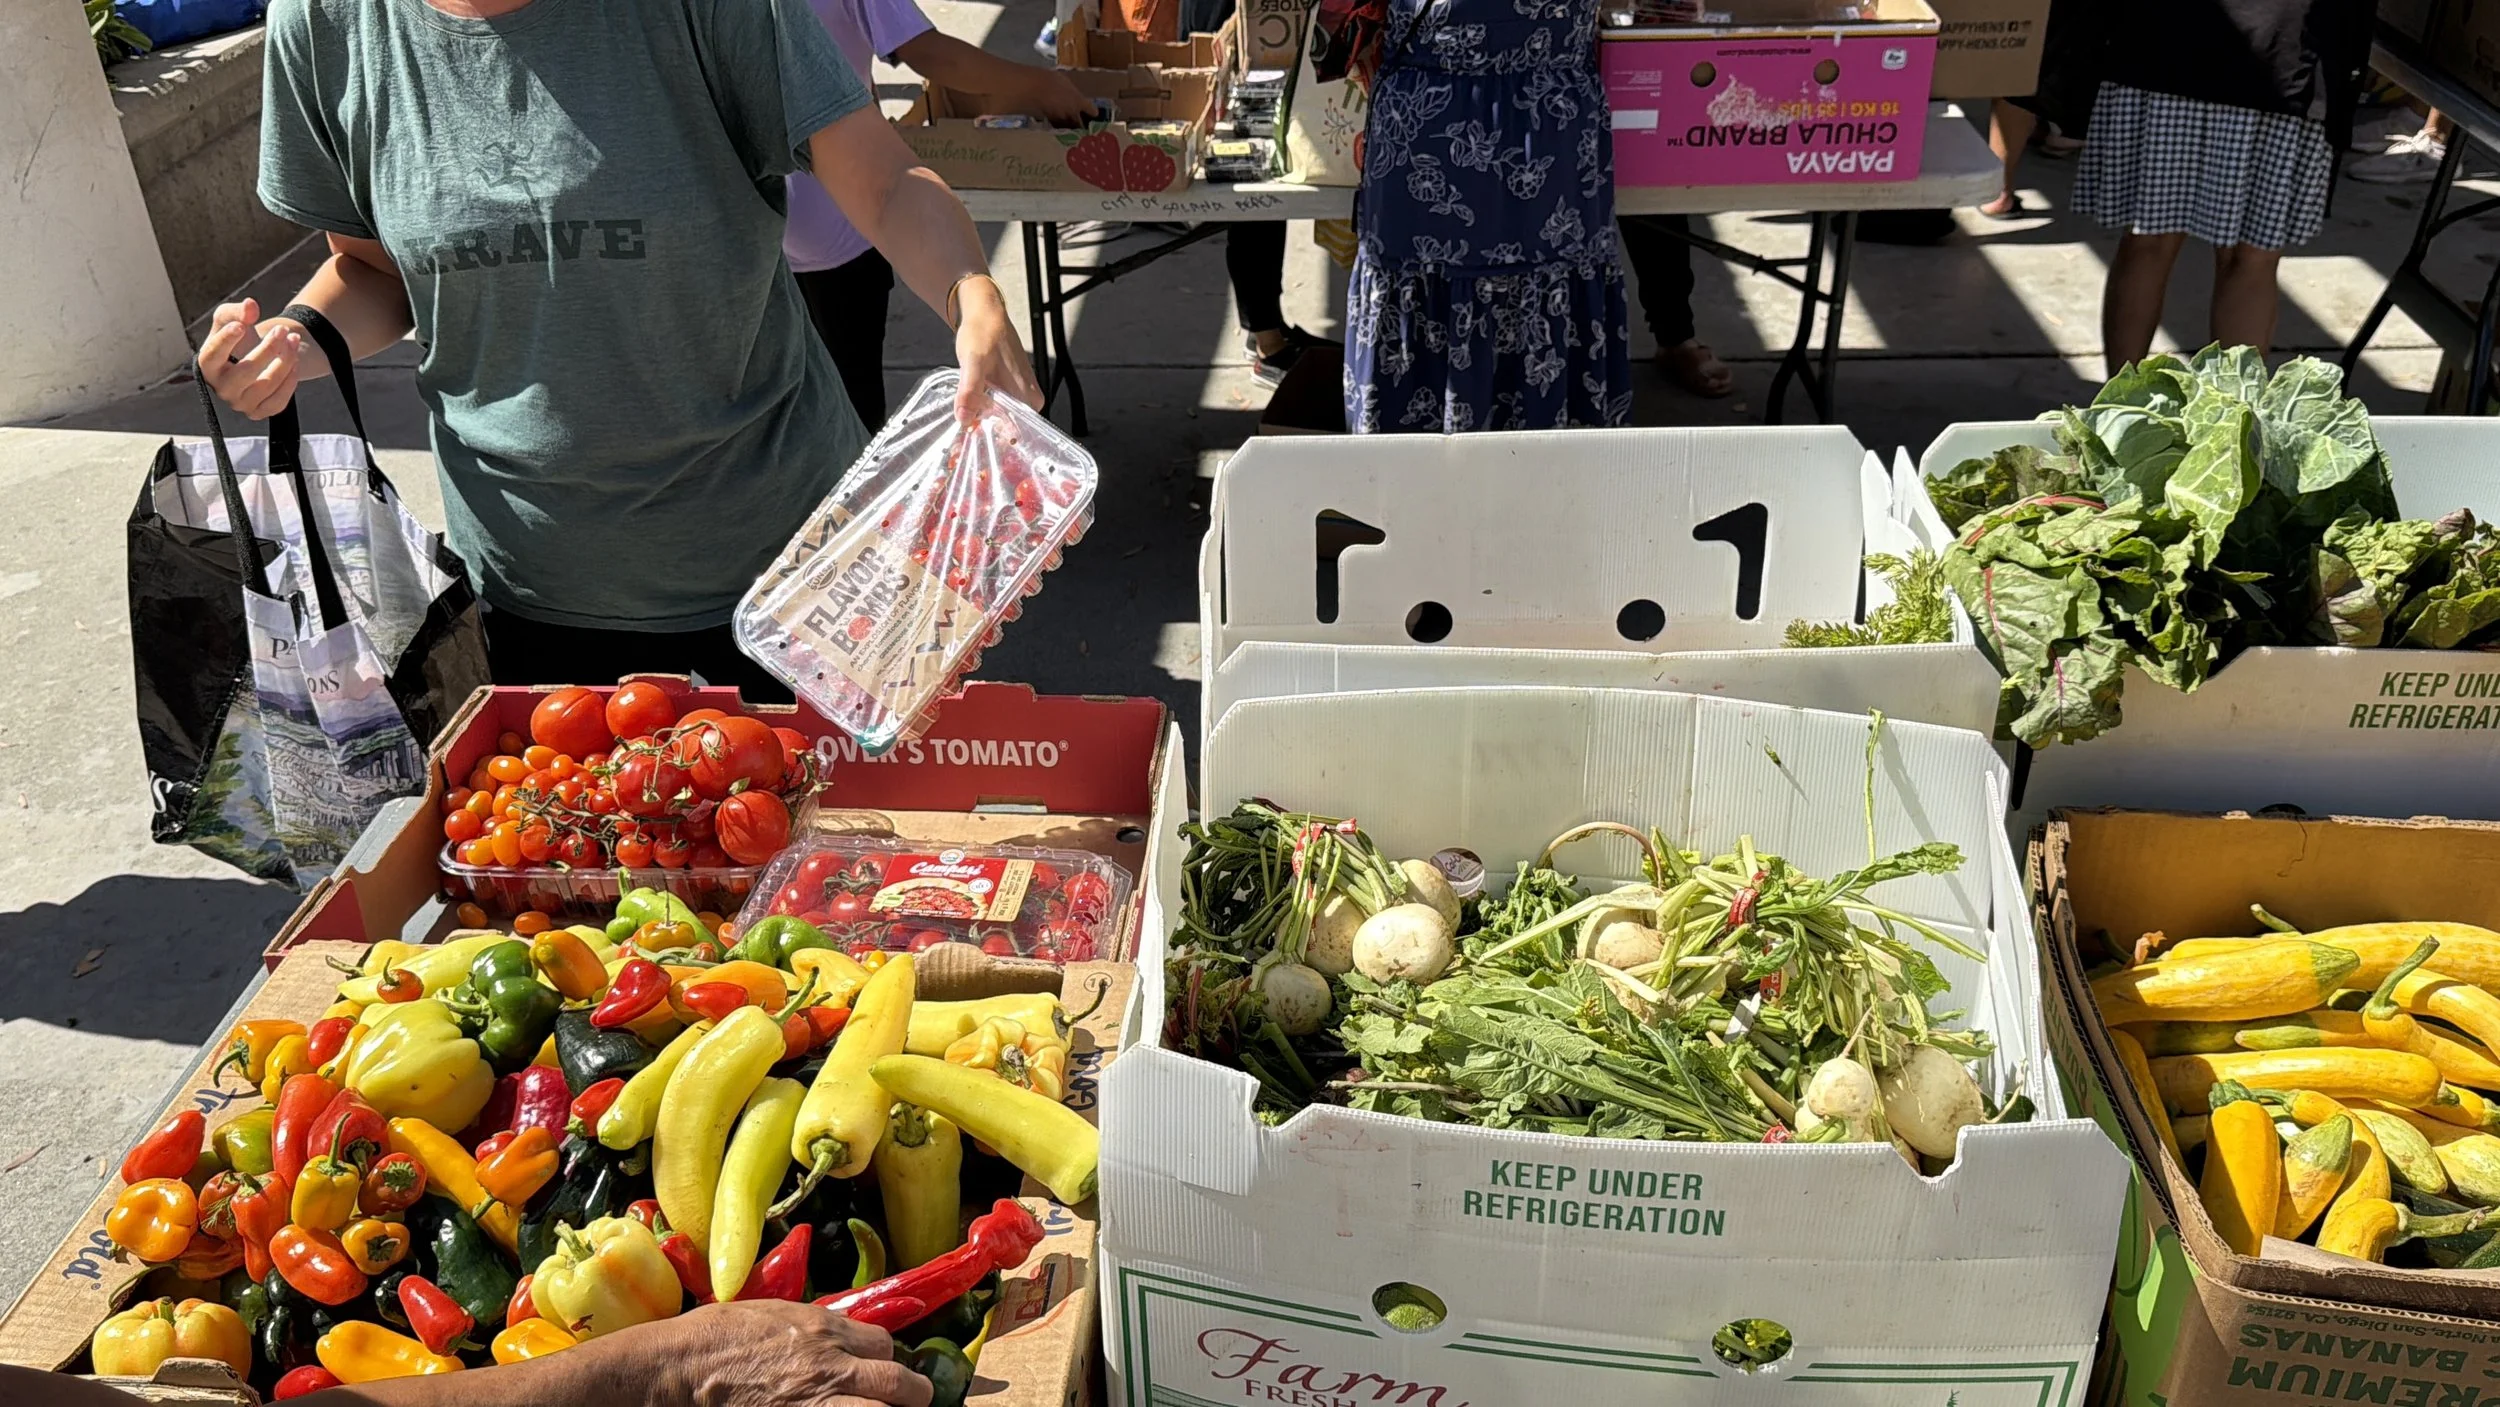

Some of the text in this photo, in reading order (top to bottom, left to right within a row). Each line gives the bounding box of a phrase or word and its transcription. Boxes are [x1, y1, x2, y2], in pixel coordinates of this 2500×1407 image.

[1849, 101, 1876, 117] KG
[1797, 122, 1898, 145] CHULA
[1002, 155, 1065, 178] Fraises
[1786, 149, 1895, 174] PAPAYA
[1101, 192, 1134, 211] CITY
[1141, 195, 1160, 210] OF
[803, 546, 885, 638] FLAVOR
[2378, 671, 2450, 698] KEEP
[908, 861, 985, 878] Campari
[1062, 1045, 1103, 1113] Gold
[1490, 1159, 1704, 1201] KEEP UNDER
[1463, 1189, 1726, 1237] REFRIGERATION
[2333, 1315, 2390, 1333] Diego,
[2393, 1321, 2427, 1337] San
[2431, 1327, 2486, 1344] Norte,
[2238, 1323, 2469, 1374] BANANAS
[1197, 1327, 1470, 1407] Farm
